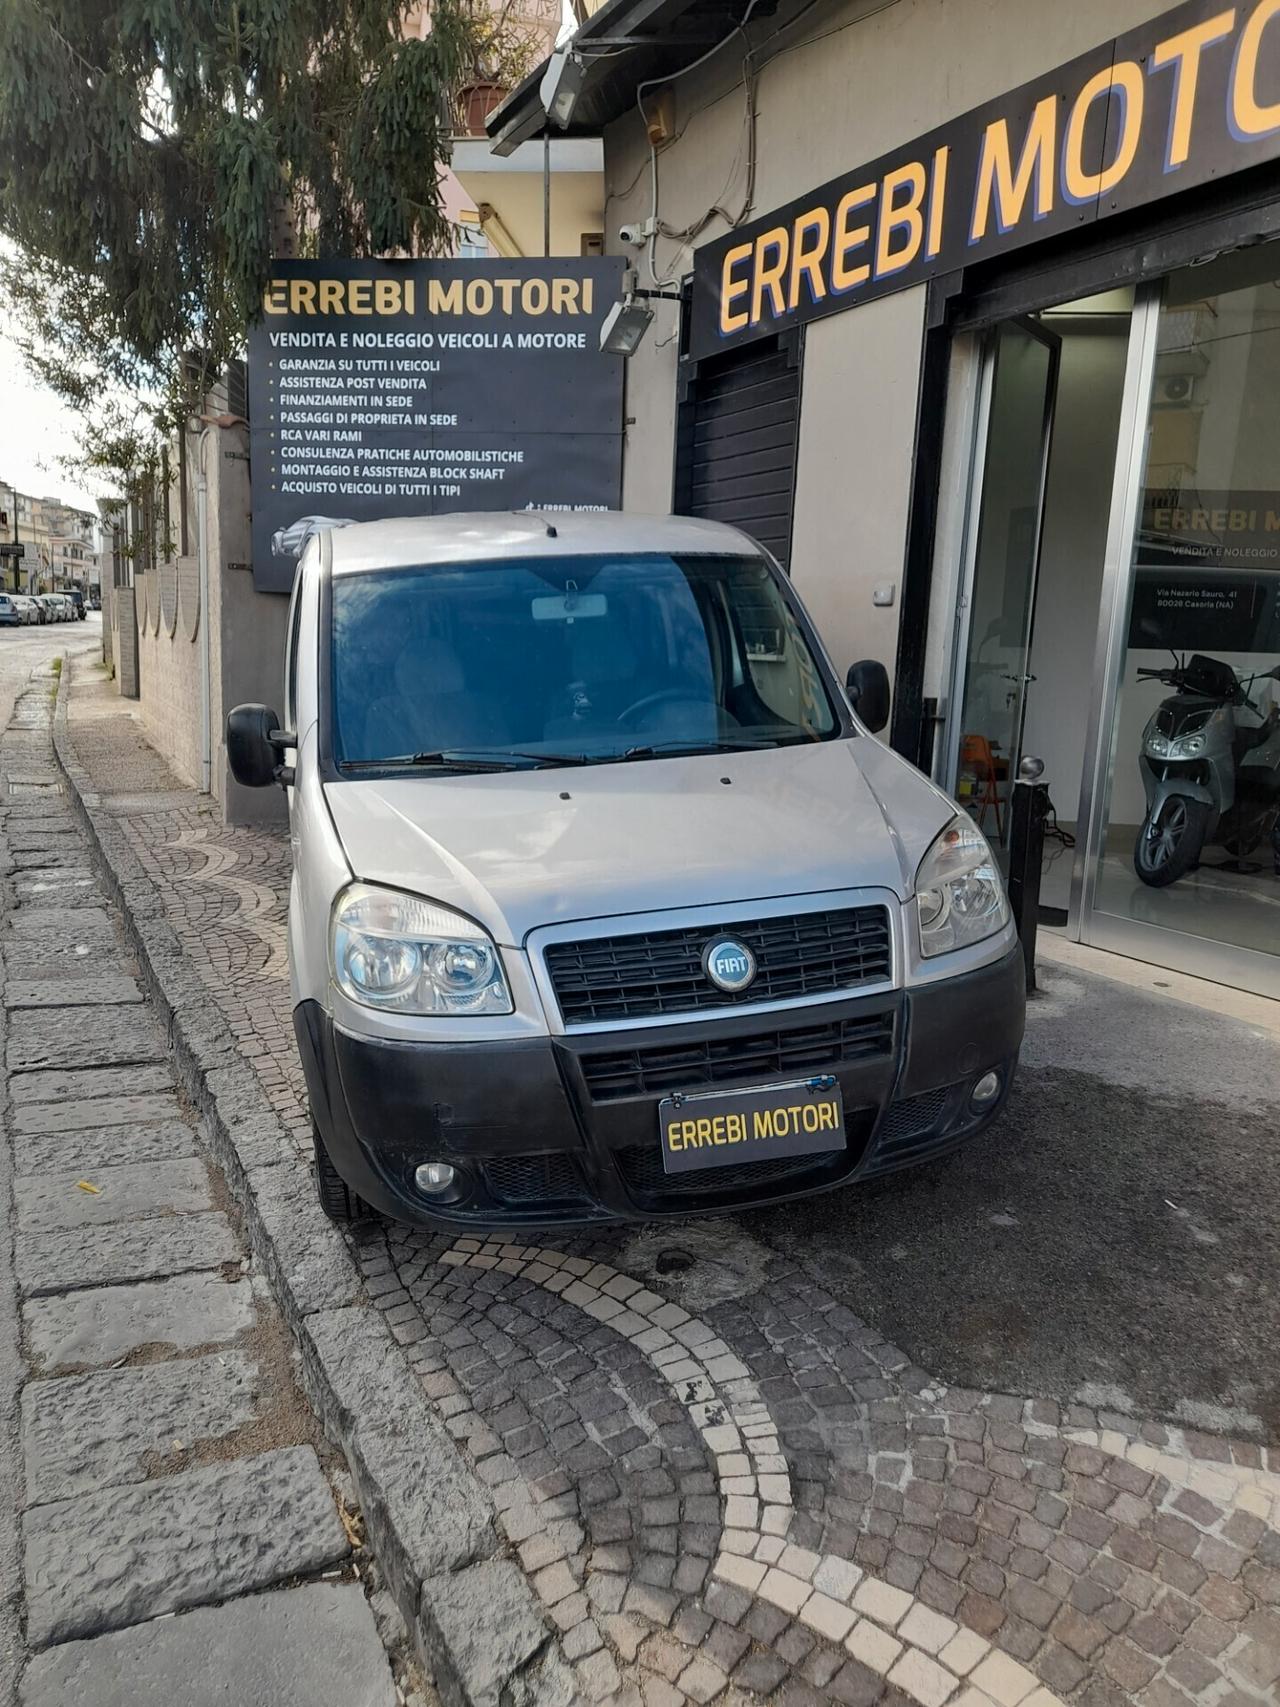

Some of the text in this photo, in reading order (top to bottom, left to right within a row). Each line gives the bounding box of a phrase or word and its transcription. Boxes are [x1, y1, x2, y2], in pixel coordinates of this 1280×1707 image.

[718, 145, 951, 335] ERREBI
[264, 278, 593, 316] ERREBI MOTORI
[269, 332, 586, 348] VENDITA E NOLEGGIO VEICOLI A MOTORE
[279, 359, 440, 371] GARANZIA SU TUTTI I VEICOLI
[280, 377, 427, 389] ASSISTENZA POST VENDITA
[280, 394, 413, 407] FINANZIAMENTI IN SEDE
[280, 412, 457, 425] PASSAGGI DI PROPRIETA IN SEDE
[280, 430, 362, 442] RCA VARI RAMI
[281, 447, 524, 462] CONSULENZA PRATICHE AUTOMOBILISTICHE
[281, 464, 505, 480] MONTAGGIO E ASSISTENZA BLOCK SHAFT
[281, 482, 460, 496] ACQUISTO VEICOLI DI TUTTI I TIPI
[1153, 508, 1257, 532] ERREBI
[1171, 546, 1215, 557] VENDITA
[1224, 547, 1278, 558] NOLEGGIO
[1157, 589, 1170, 597] Via
[1215, 600, 1234, 610] (NA)
[716, 955, 746, 975] FIAT
[667, 1101, 840, 1150] ERREBI MOTORI
